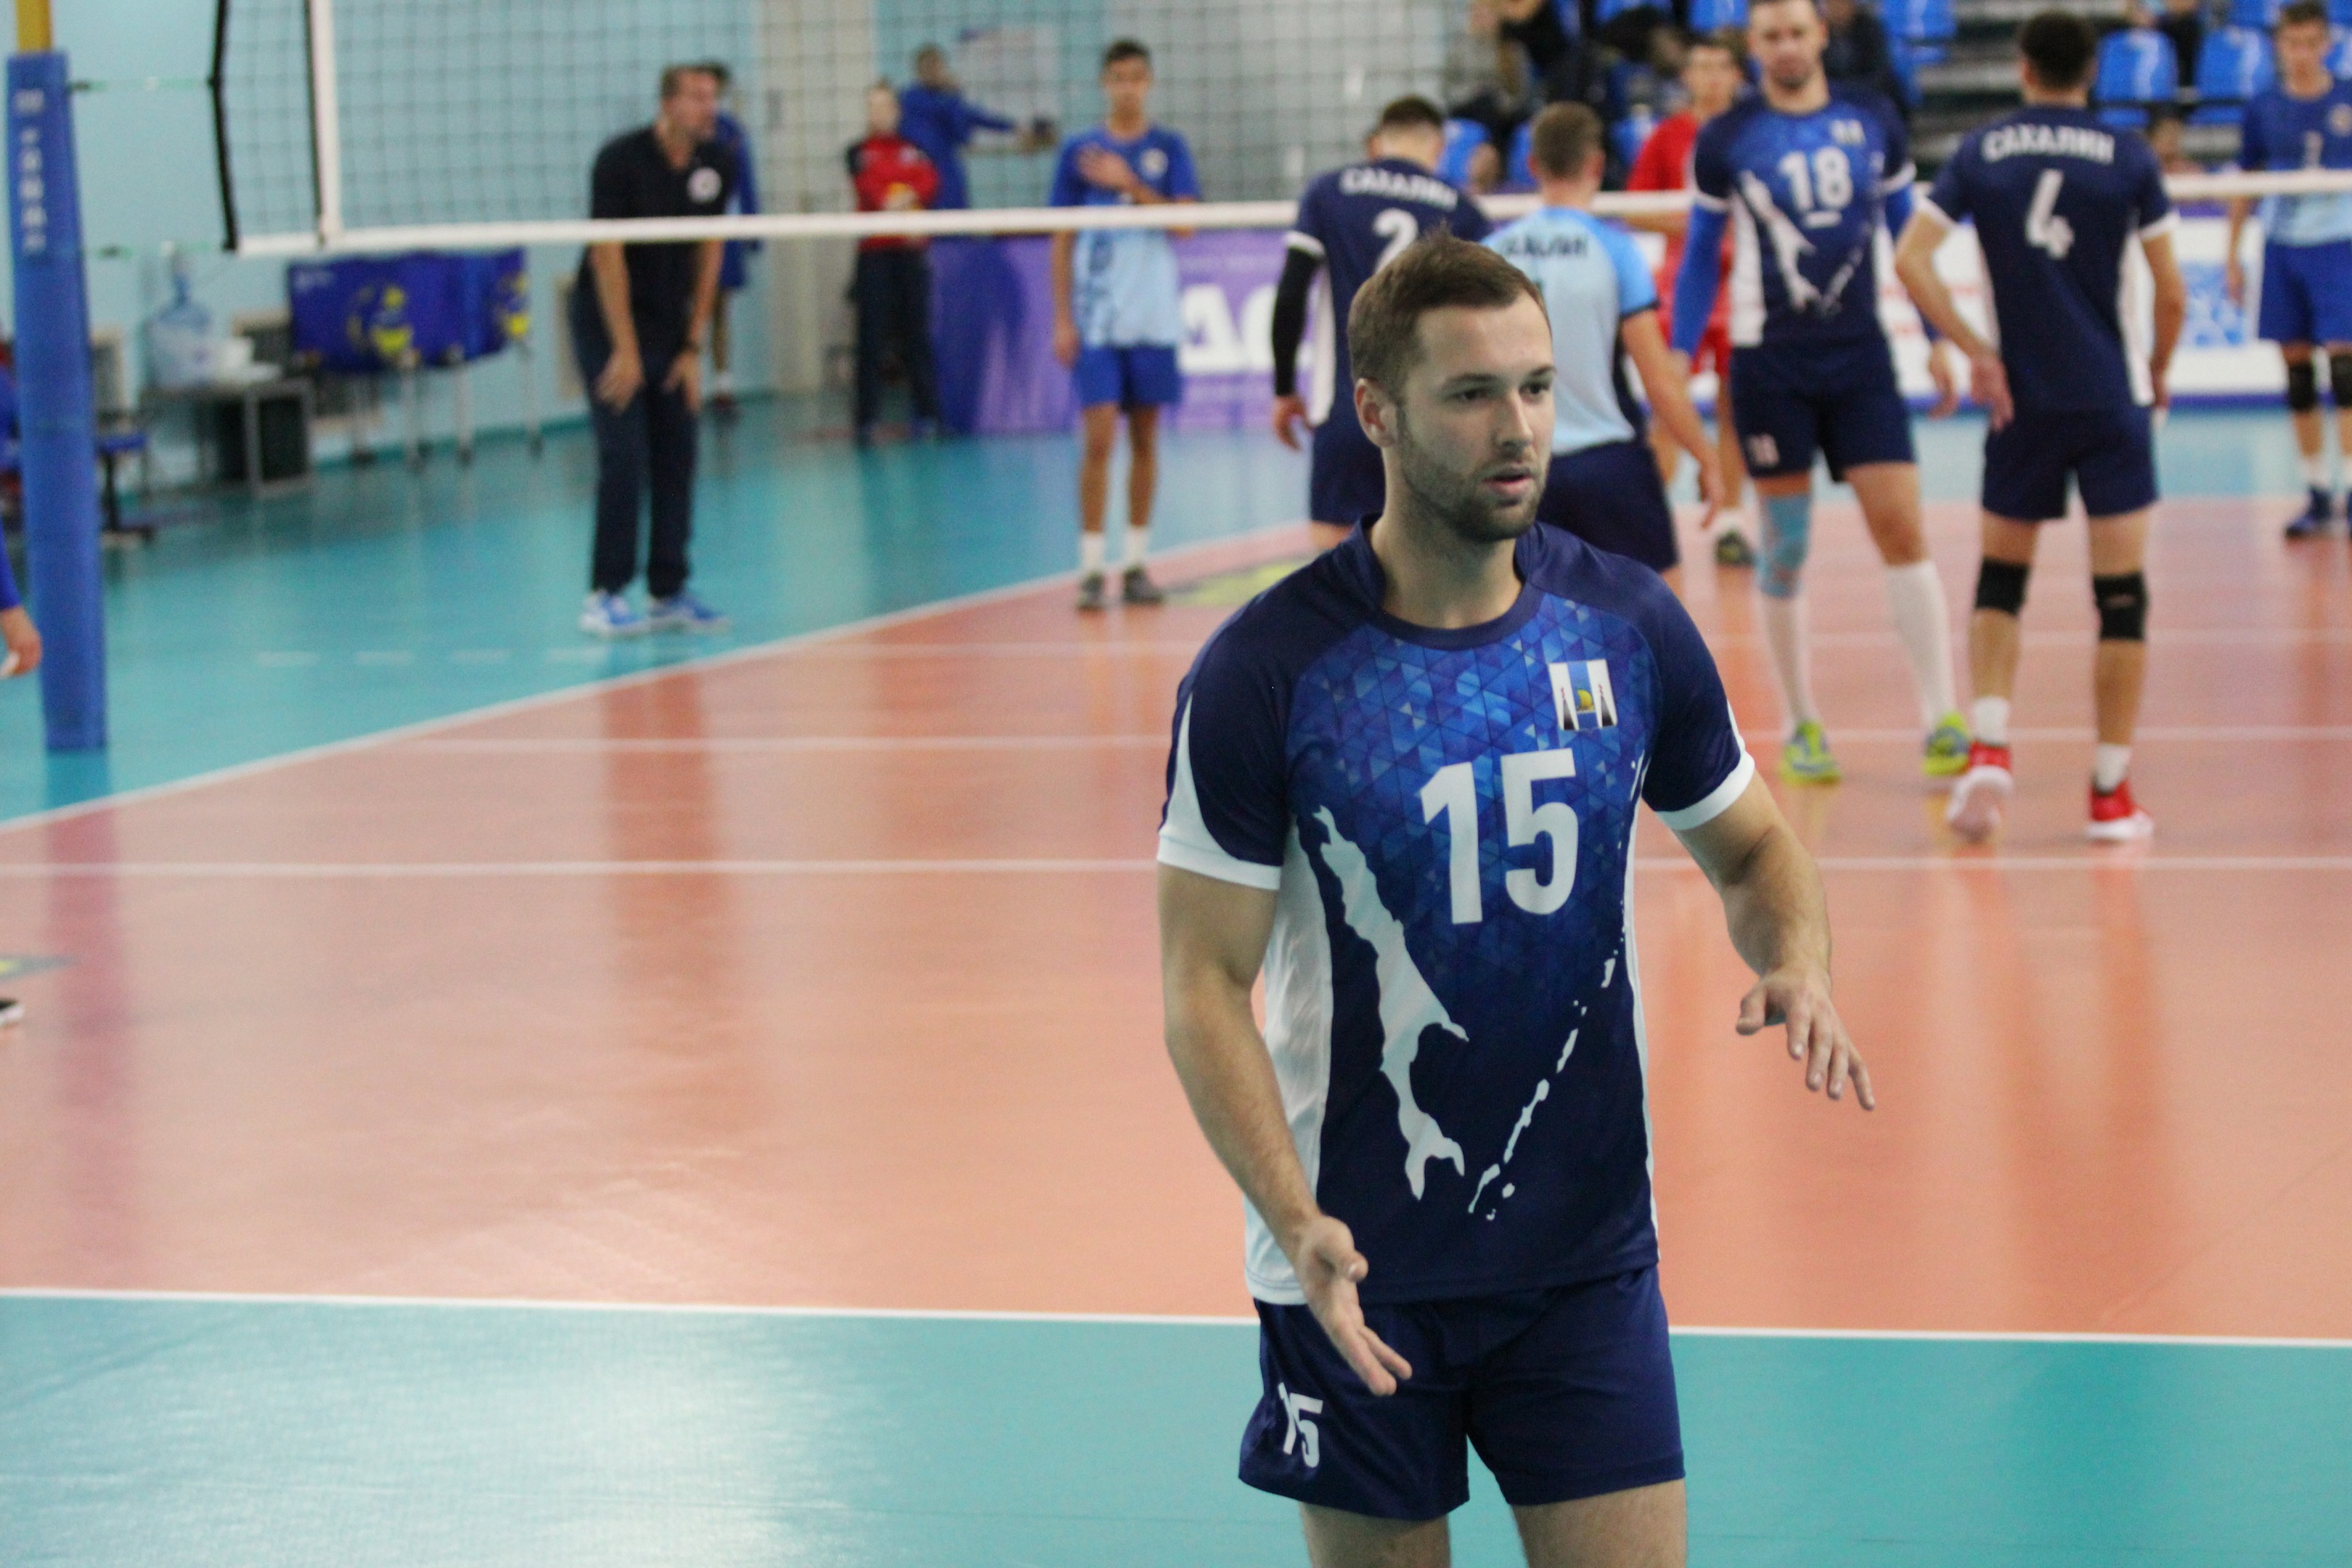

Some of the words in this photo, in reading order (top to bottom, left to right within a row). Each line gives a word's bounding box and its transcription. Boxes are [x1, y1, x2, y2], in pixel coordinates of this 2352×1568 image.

[1777, 146, 1853, 213] 18
[2025, 168, 2075, 259] 4
[1372, 207, 1419, 274] 2
[1420, 747, 1579, 925] 15
[1278, 1381, 1324, 1468] 15
